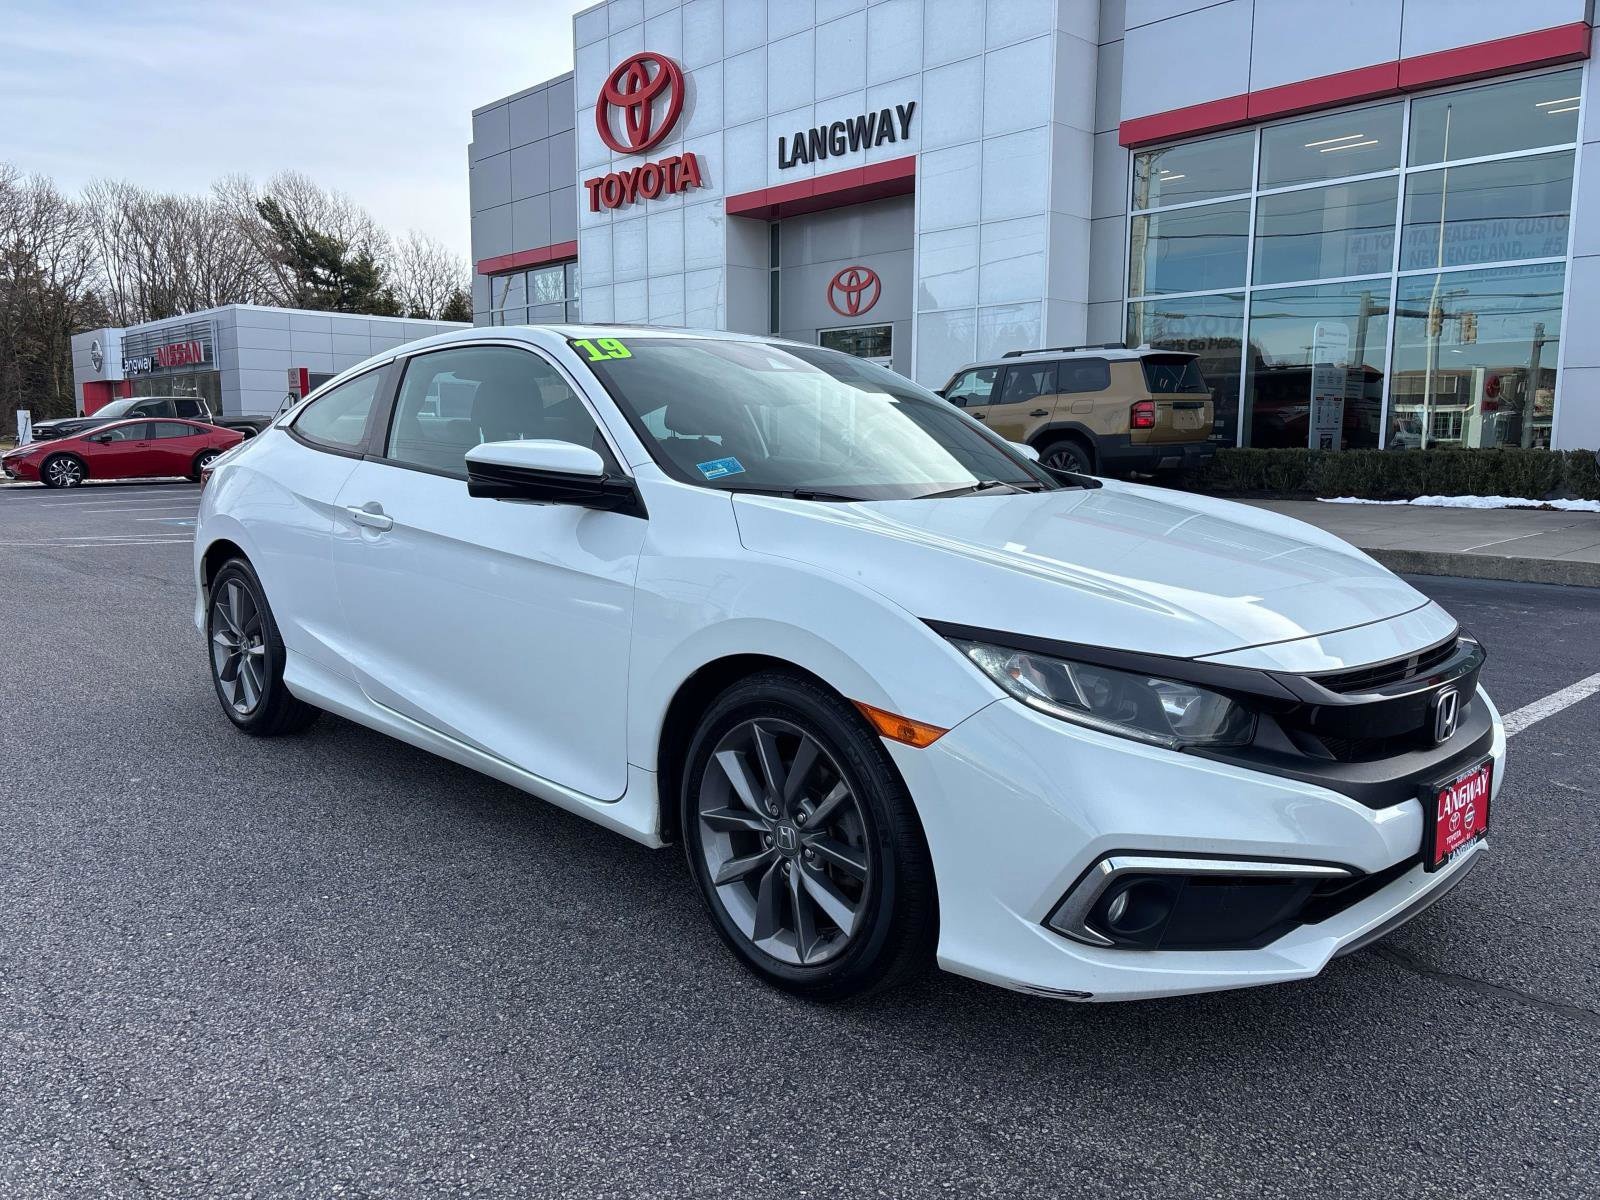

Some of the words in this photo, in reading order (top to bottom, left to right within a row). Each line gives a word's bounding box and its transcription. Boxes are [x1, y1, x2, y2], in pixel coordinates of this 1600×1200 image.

[778, 101, 916, 169] LANGWAY
[584, 152, 701, 213] TOYOTA
[1375, 229, 1429, 252] TOTA
[1492, 221, 1510, 238] IN
[157, 340, 204, 368] NISSAN
[573, 338, 633, 362] 19
[1188, 339, 1205, 351] Go
[121, 356, 152, 375] Langway
[1437, 771, 1489, 822] LANGWAY
[1446, 830, 1461, 845] TOYOTA
